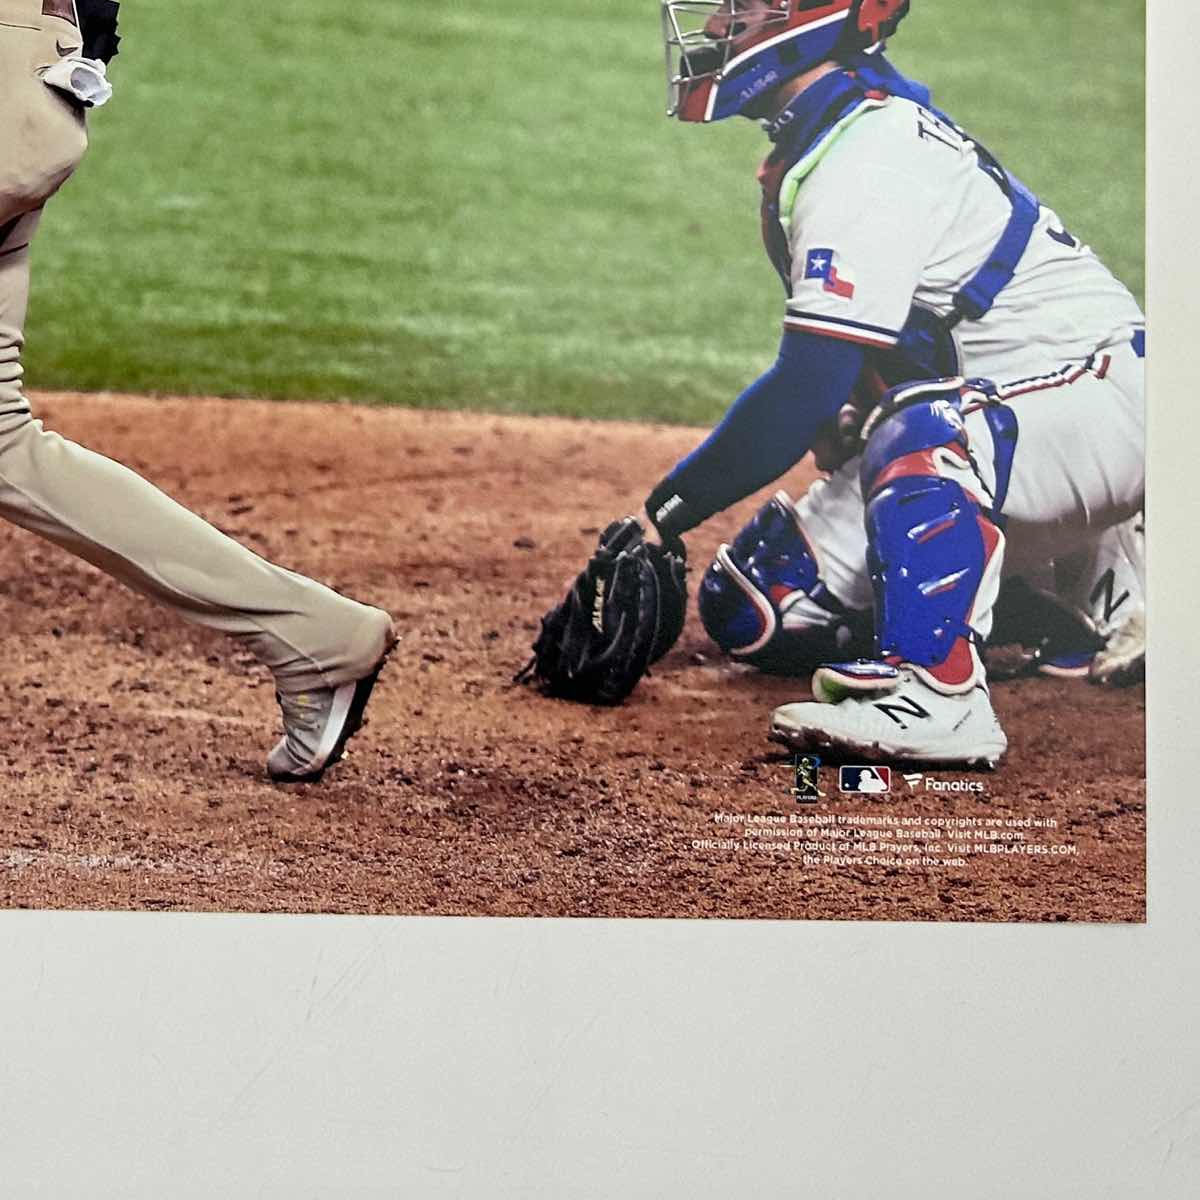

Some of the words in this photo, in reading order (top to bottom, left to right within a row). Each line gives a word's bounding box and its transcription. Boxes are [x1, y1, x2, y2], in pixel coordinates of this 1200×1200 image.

[925, 777, 984, 792] Fanatics
[714, 814, 744, 824] Major
[748, 815, 786, 825] League
[790, 815, 835, 824] Baseball
[838, 816, 898, 825] trademarks
[901, 816, 921, 826] and
[925, 817, 982, 829] copyrights
[985, 819, 1002, 827] are
[1006, 818, 1031, 827] used
[1034, 818, 1057, 827] with
[745, 828, 802, 837] permission
[806, 828, 817, 837] of
[821, 828, 850, 838] Major
[854, 829, 892, 839] League
[947, 830, 972, 839] Visit
[692, 839, 740, 851] Officially
[743, 841, 791, 850] Licensed
[794, 841, 836, 851] Product
[840, 841, 850, 851] of
[853, 842, 876, 851] MLB
[947, 844, 971, 853] Visit
[803, 855, 820, 865] the
[823, 856, 863, 866] Players
[866, 856, 903, 865] Choice
[905, 858, 920, 866] on
[922, 857, 939, 866] the
